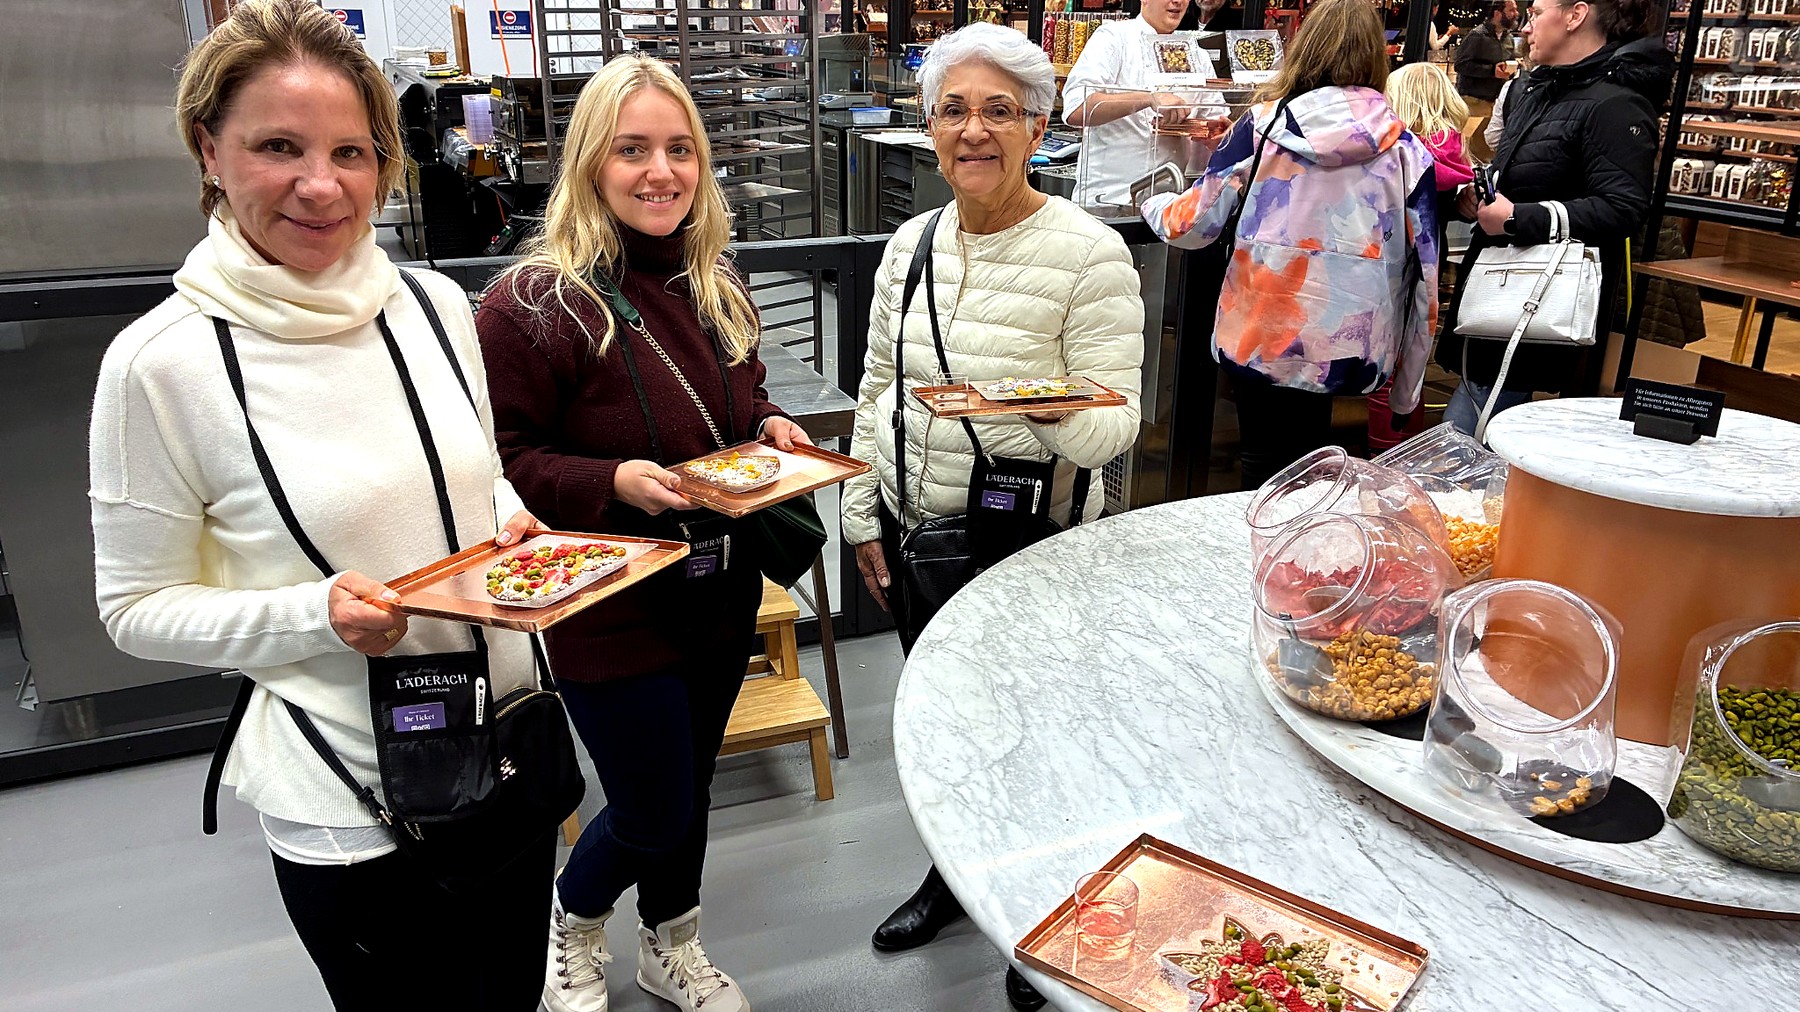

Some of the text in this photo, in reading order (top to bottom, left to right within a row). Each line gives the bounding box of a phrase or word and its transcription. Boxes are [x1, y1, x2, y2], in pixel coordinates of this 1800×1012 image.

[1645, 390, 1678, 400] Informationen
[396, 673, 468, 689] LÄDERACH
[415, 714, 435, 722] Ticket
